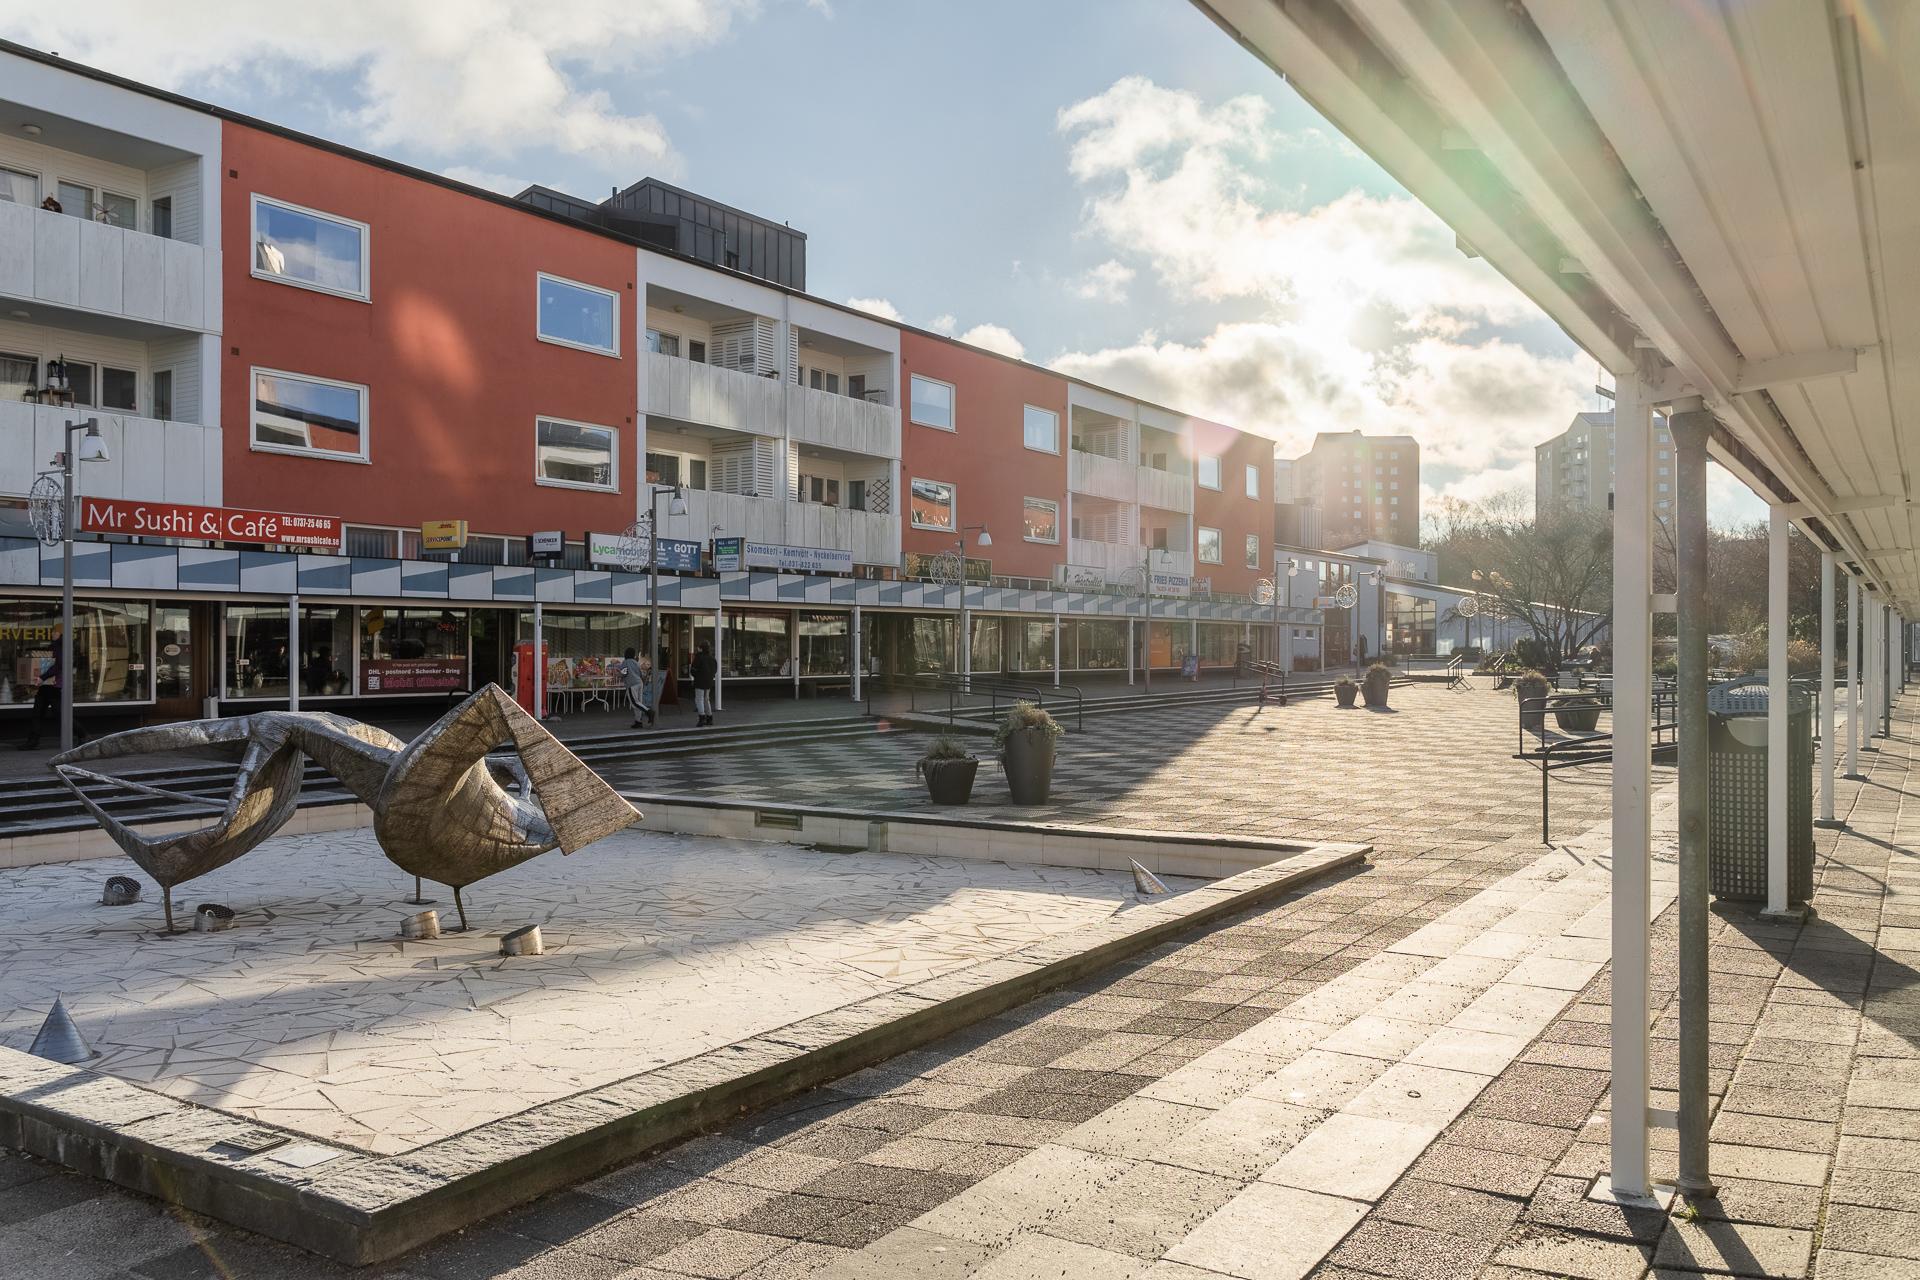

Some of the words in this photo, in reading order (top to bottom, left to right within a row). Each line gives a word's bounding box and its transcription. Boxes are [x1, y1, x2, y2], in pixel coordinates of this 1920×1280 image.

[87, 503, 127, 528] Mr
[134, 507, 193, 533] Sushi
[199, 513, 219, 534] &
[227, 514, 278, 538] Café
[282, 516, 293, 527] TEL:
[315, 520, 323, 530] 46
[674, 543, 698, 555] GOTT
[746, 544, 778, 555] Skomakeri
[783, 548, 809, 559] Kemtvätt
[813, 552, 851, 562] Nyckelservice
